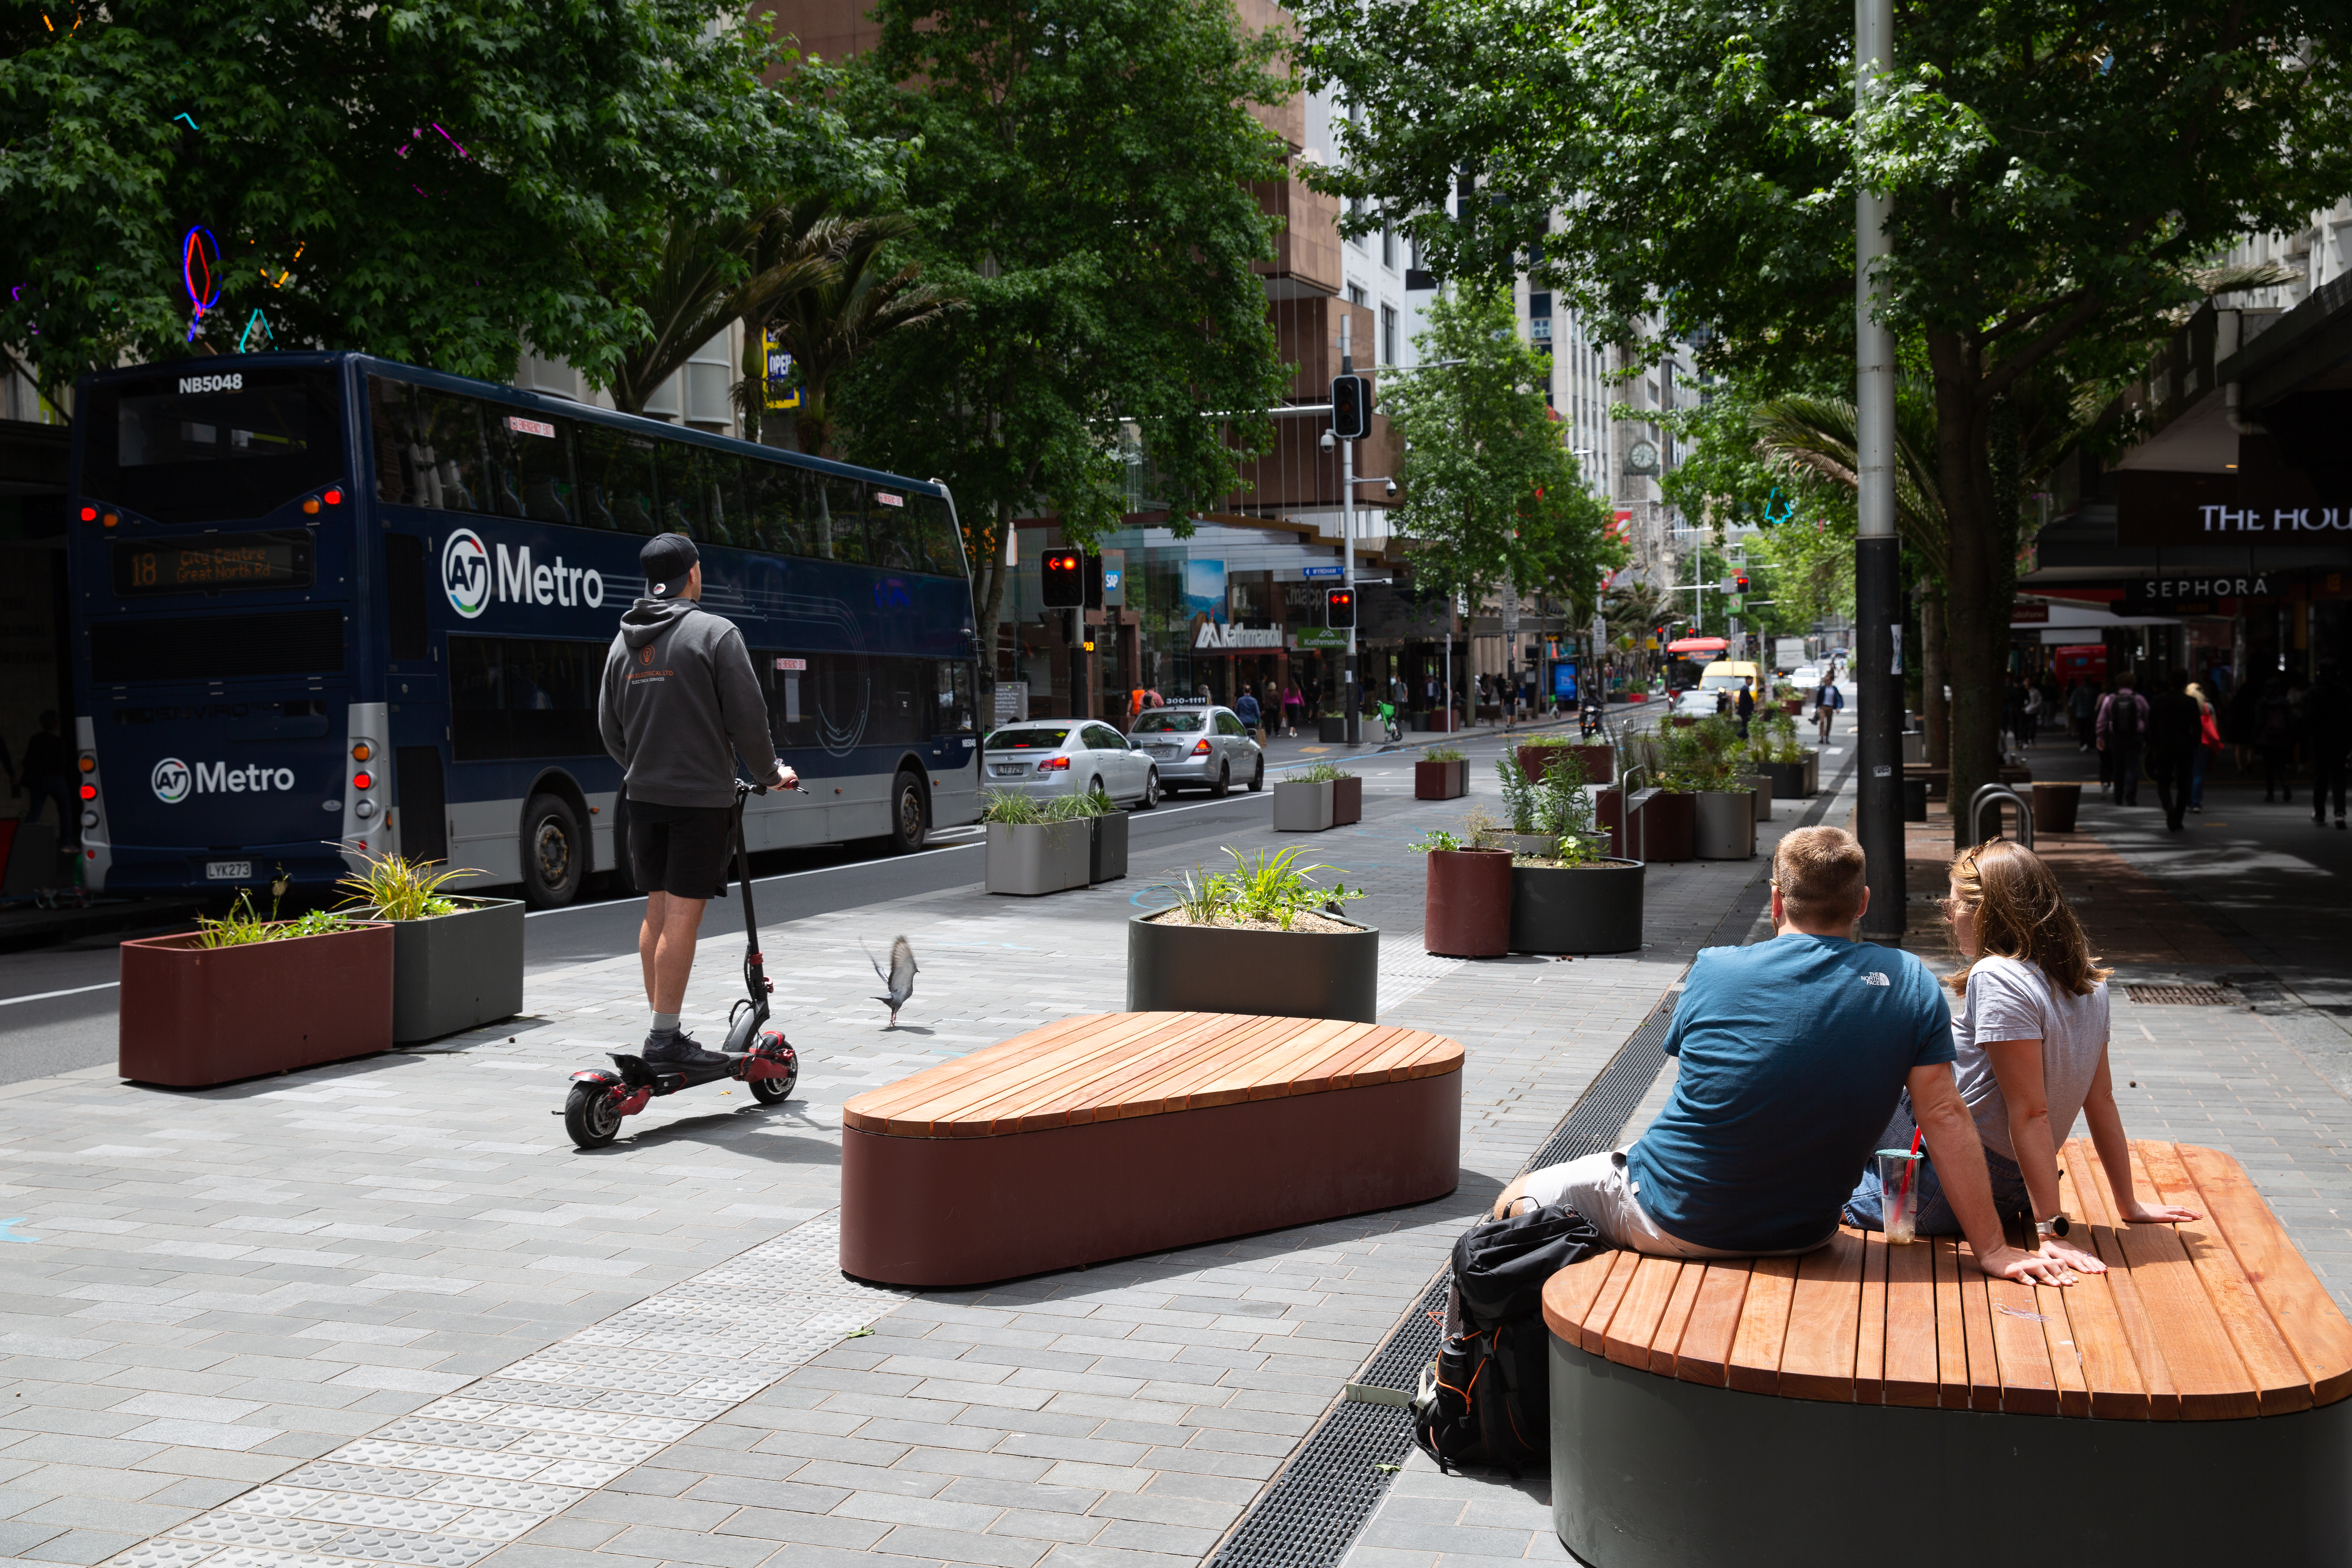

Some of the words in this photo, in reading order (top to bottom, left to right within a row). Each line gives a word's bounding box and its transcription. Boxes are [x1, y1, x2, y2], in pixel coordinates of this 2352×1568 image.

[179, 373, 243, 394] NB5048
[2198, 505, 2265, 531] THE
[2273, 508, 2352, 531] HOU
[180, 550, 209, 566] City
[214, 548, 265, 564] Centre
[133, 552, 157, 586] 18
[177, 566, 212, 584] Great
[216, 564, 251, 581] North
[254, 561, 270, 578] Rd
[496, 543, 604, 608] Metro
[1106, 574, 1118, 588] SAP
[2146, 578, 2268, 598] SEPHORA
[1220, 622, 1283, 647] Kathmandu
[156, 703, 249, 720] ENVIRO
[962, 738, 976, 748] NB5048
[195, 761, 295, 793] Metro
[999, 766, 1022, 774] LTF729
[208, 863, 251, 878] LYK273
